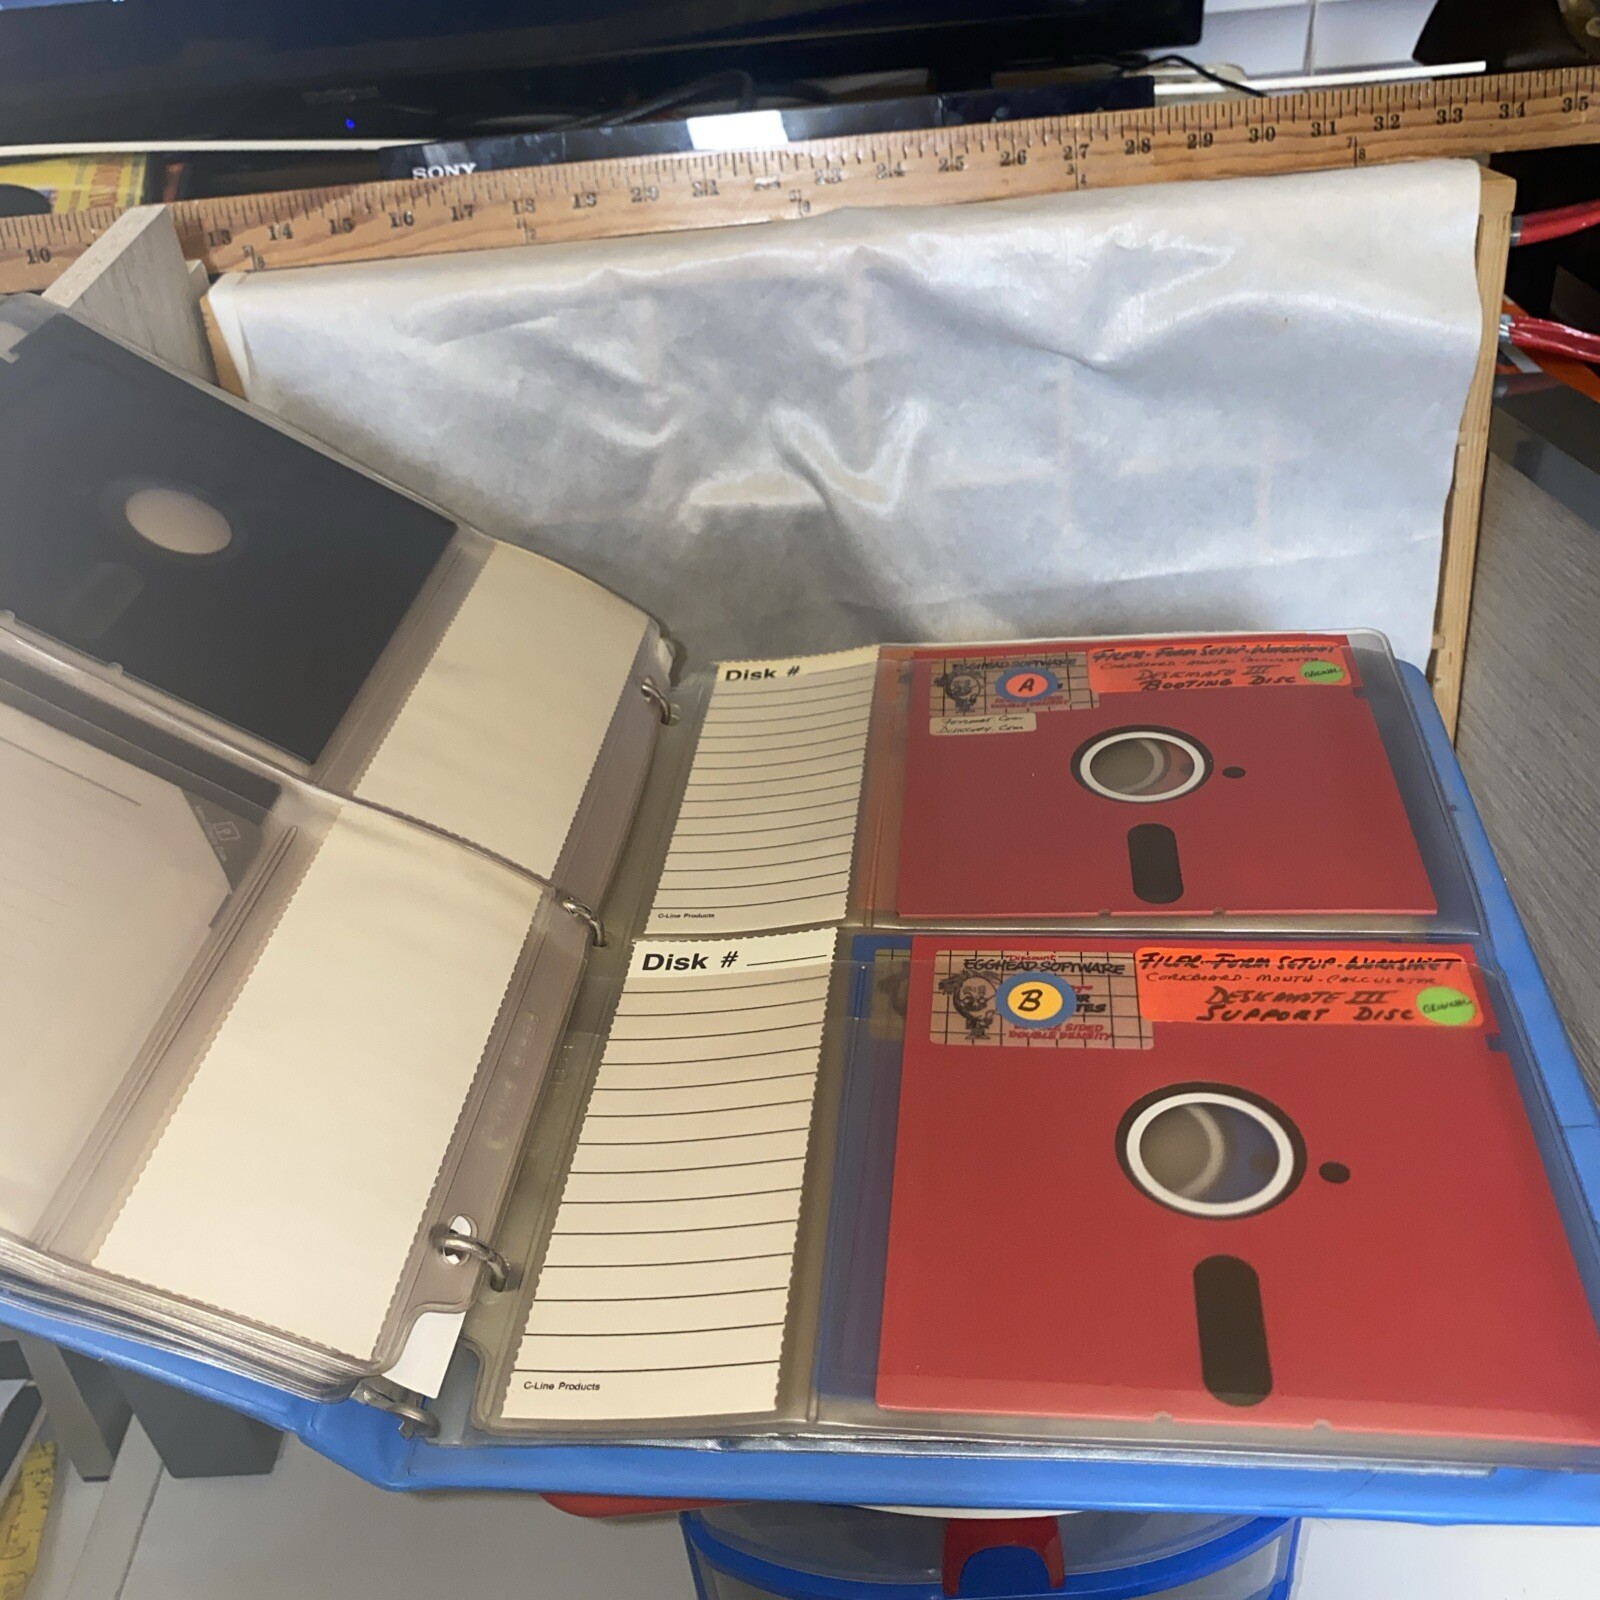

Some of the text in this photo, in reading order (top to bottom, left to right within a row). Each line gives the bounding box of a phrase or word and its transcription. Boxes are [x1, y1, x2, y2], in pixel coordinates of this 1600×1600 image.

[412, 162, 477, 180] SONY
[26, 249, 51, 264] 10
[208, 230, 232, 247] 13
[268, 223, 293, 241] 14
[329, 217, 354, 235] 15
[389, 211, 415, 228] 16
[450, 204, 474, 221] 17
[513, 198, 536, 214] 18
[573, 192, 597, 209] 19
[938, 155, 965, 172] 25
[1000, 150, 1027, 166] 26
[1063, 144, 1089, 160] 27
[1125, 138, 1151, 155] 28
[1187, 133, 1213, 149] 29
[1249, 126, 1276, 143] 30
[1311, 120, 1337, 137] 31
[1374, 114, 1400, 131] 32
[1436, 107, 1463, 125] 33
[1499, 101, 1526, 119] 34
[1561, 95, 1589, 113] 35
[725, 666, 801, 681] Disk #
[1017, 677, 1035, 692] A
[641, 950, 739, 971] Disk #
[1007, 954, 1056, 962] Discount
[963, 958, 1125, 975] EGGHEAD SOFTWARE
[1018, 988, 1044, 1012] B
[1196, 1004, 1415, 1021] SUPPORT DISC
[1008, 1030, 1112, 1041] DOUBLE DENSITY
[1064, 1023, 1104, 1032] SIDED
[523, 1381, 600, 1390] C-Line Products
